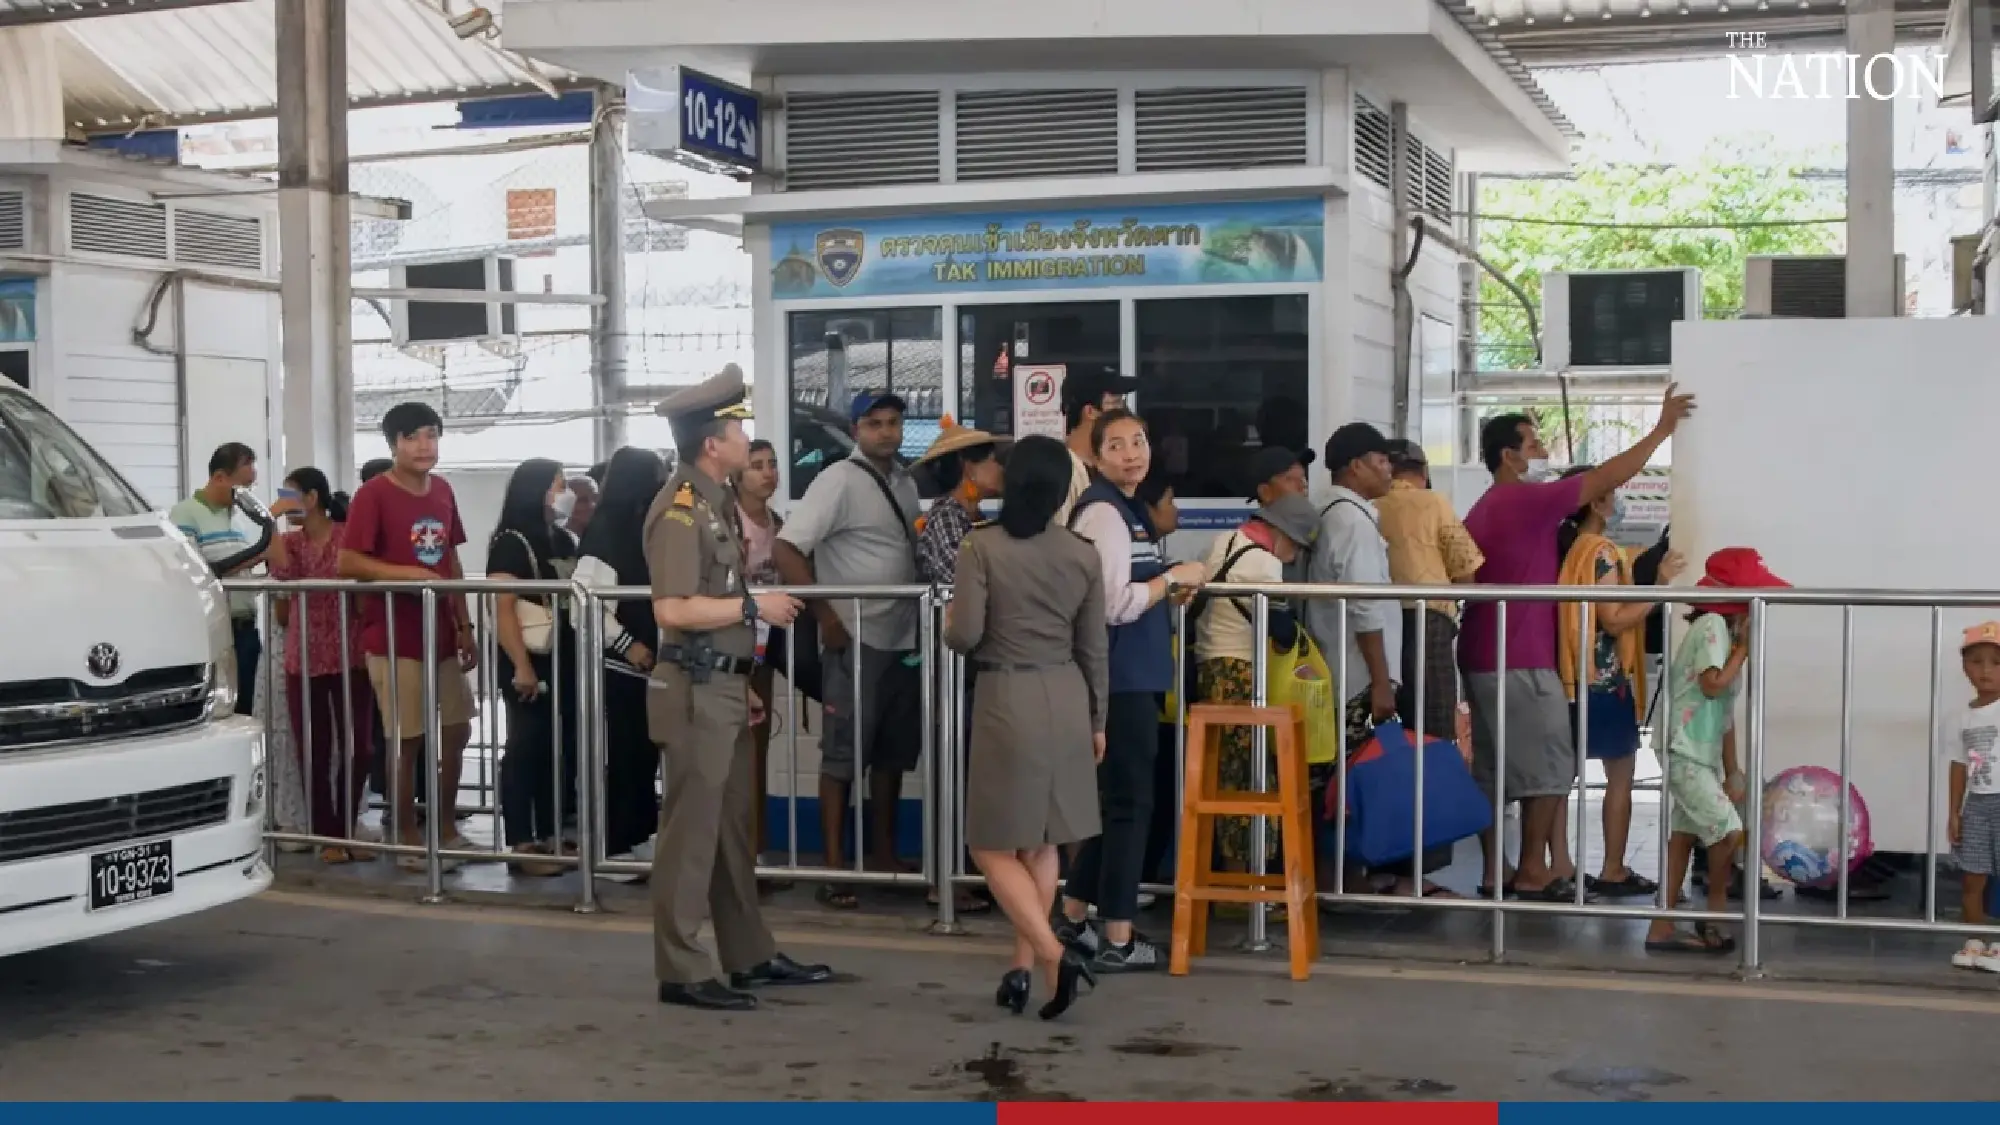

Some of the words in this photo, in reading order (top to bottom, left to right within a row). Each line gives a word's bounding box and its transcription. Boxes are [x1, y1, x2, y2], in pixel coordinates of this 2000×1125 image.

[684, 88, 738, 149] 10-12
[879, 217, 1201, 258] ตรวจคนเข้าเมืองจังหวัดตาก
[934, 261, 977, 282] TAK
[986, 254, 1145, 281] IMMIGRATION
[97, 855, 169, 897] 10-9373
